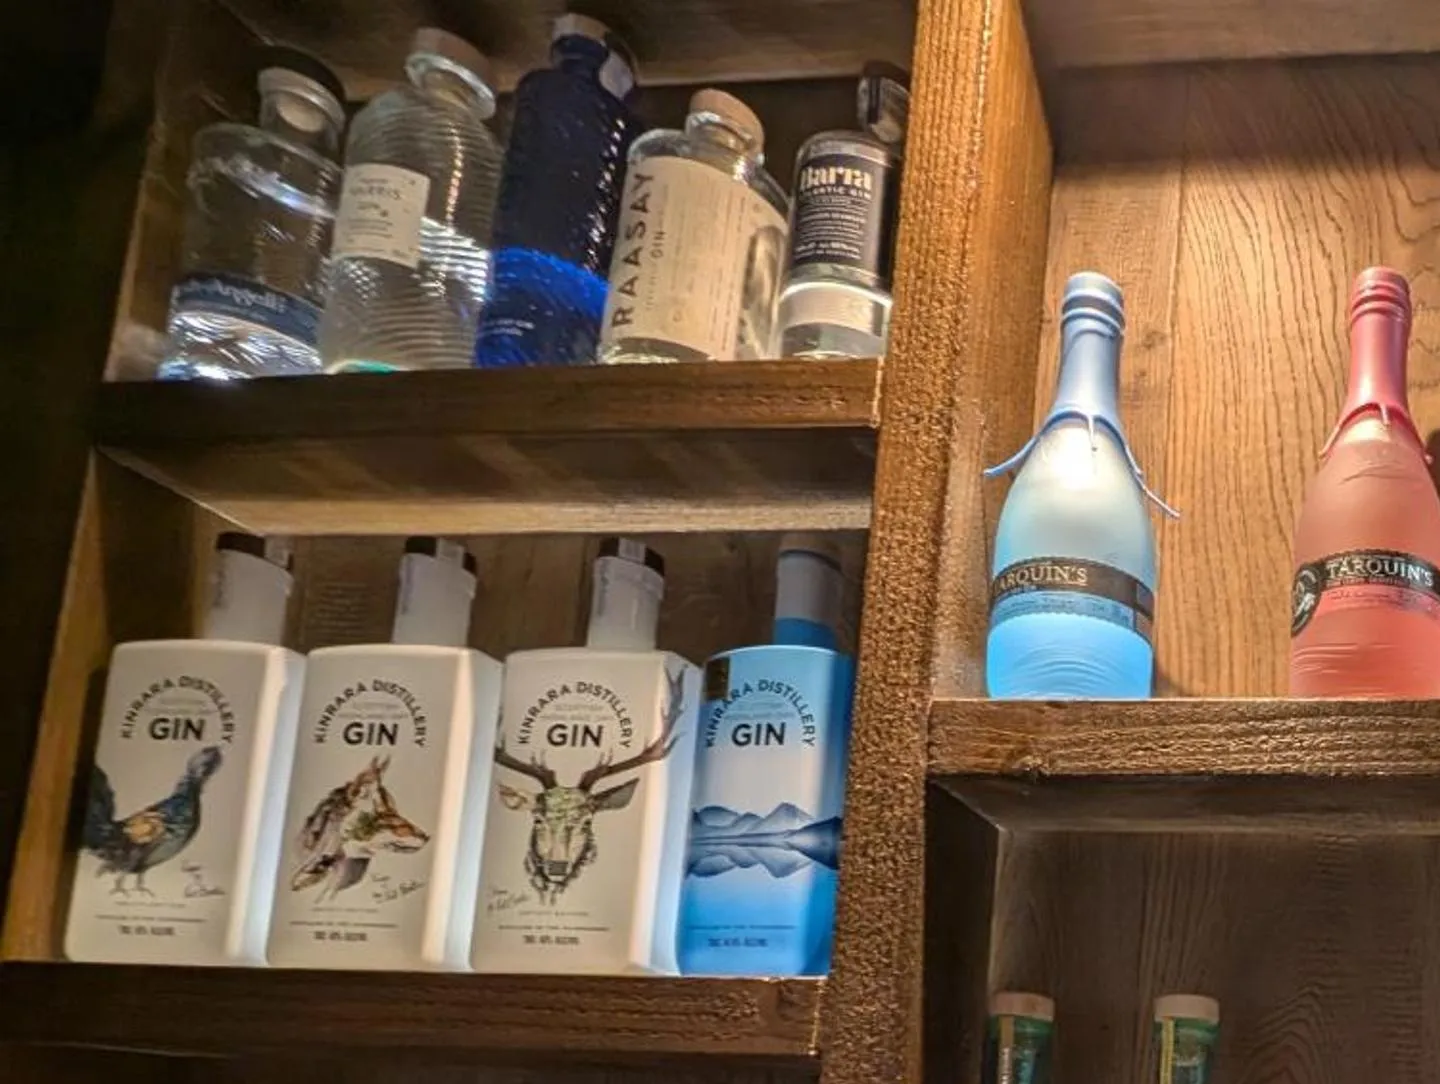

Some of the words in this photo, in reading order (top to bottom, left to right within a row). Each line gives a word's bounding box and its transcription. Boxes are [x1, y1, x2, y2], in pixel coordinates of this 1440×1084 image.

[611, 172, 654, 328] RAASAY
[998, 565, 1089, 593] ARQUIN'S
[1324, 555, 1435, 588] TARQUIN'S
[120, 678, 175, 740] KINRARA
[178, 675, 235, 743] DISTILLERY
[313, 682, 367, 744] KINRARA
[371, 679, 427, 748] DISTILLERY
[518, 684, 571, 744] KINRARA
[576, 681, 633, 748] DISTILLERY
[705, 682, 753, 748] KINRARA
[758, 679, 816, 747] DISTILLERY
[149, 717, 206, 741] GIN
[342, 721, 399, 746] GIN
[546, 723, 604, 748] GIN
[731, 722, 786, 747] GIN
